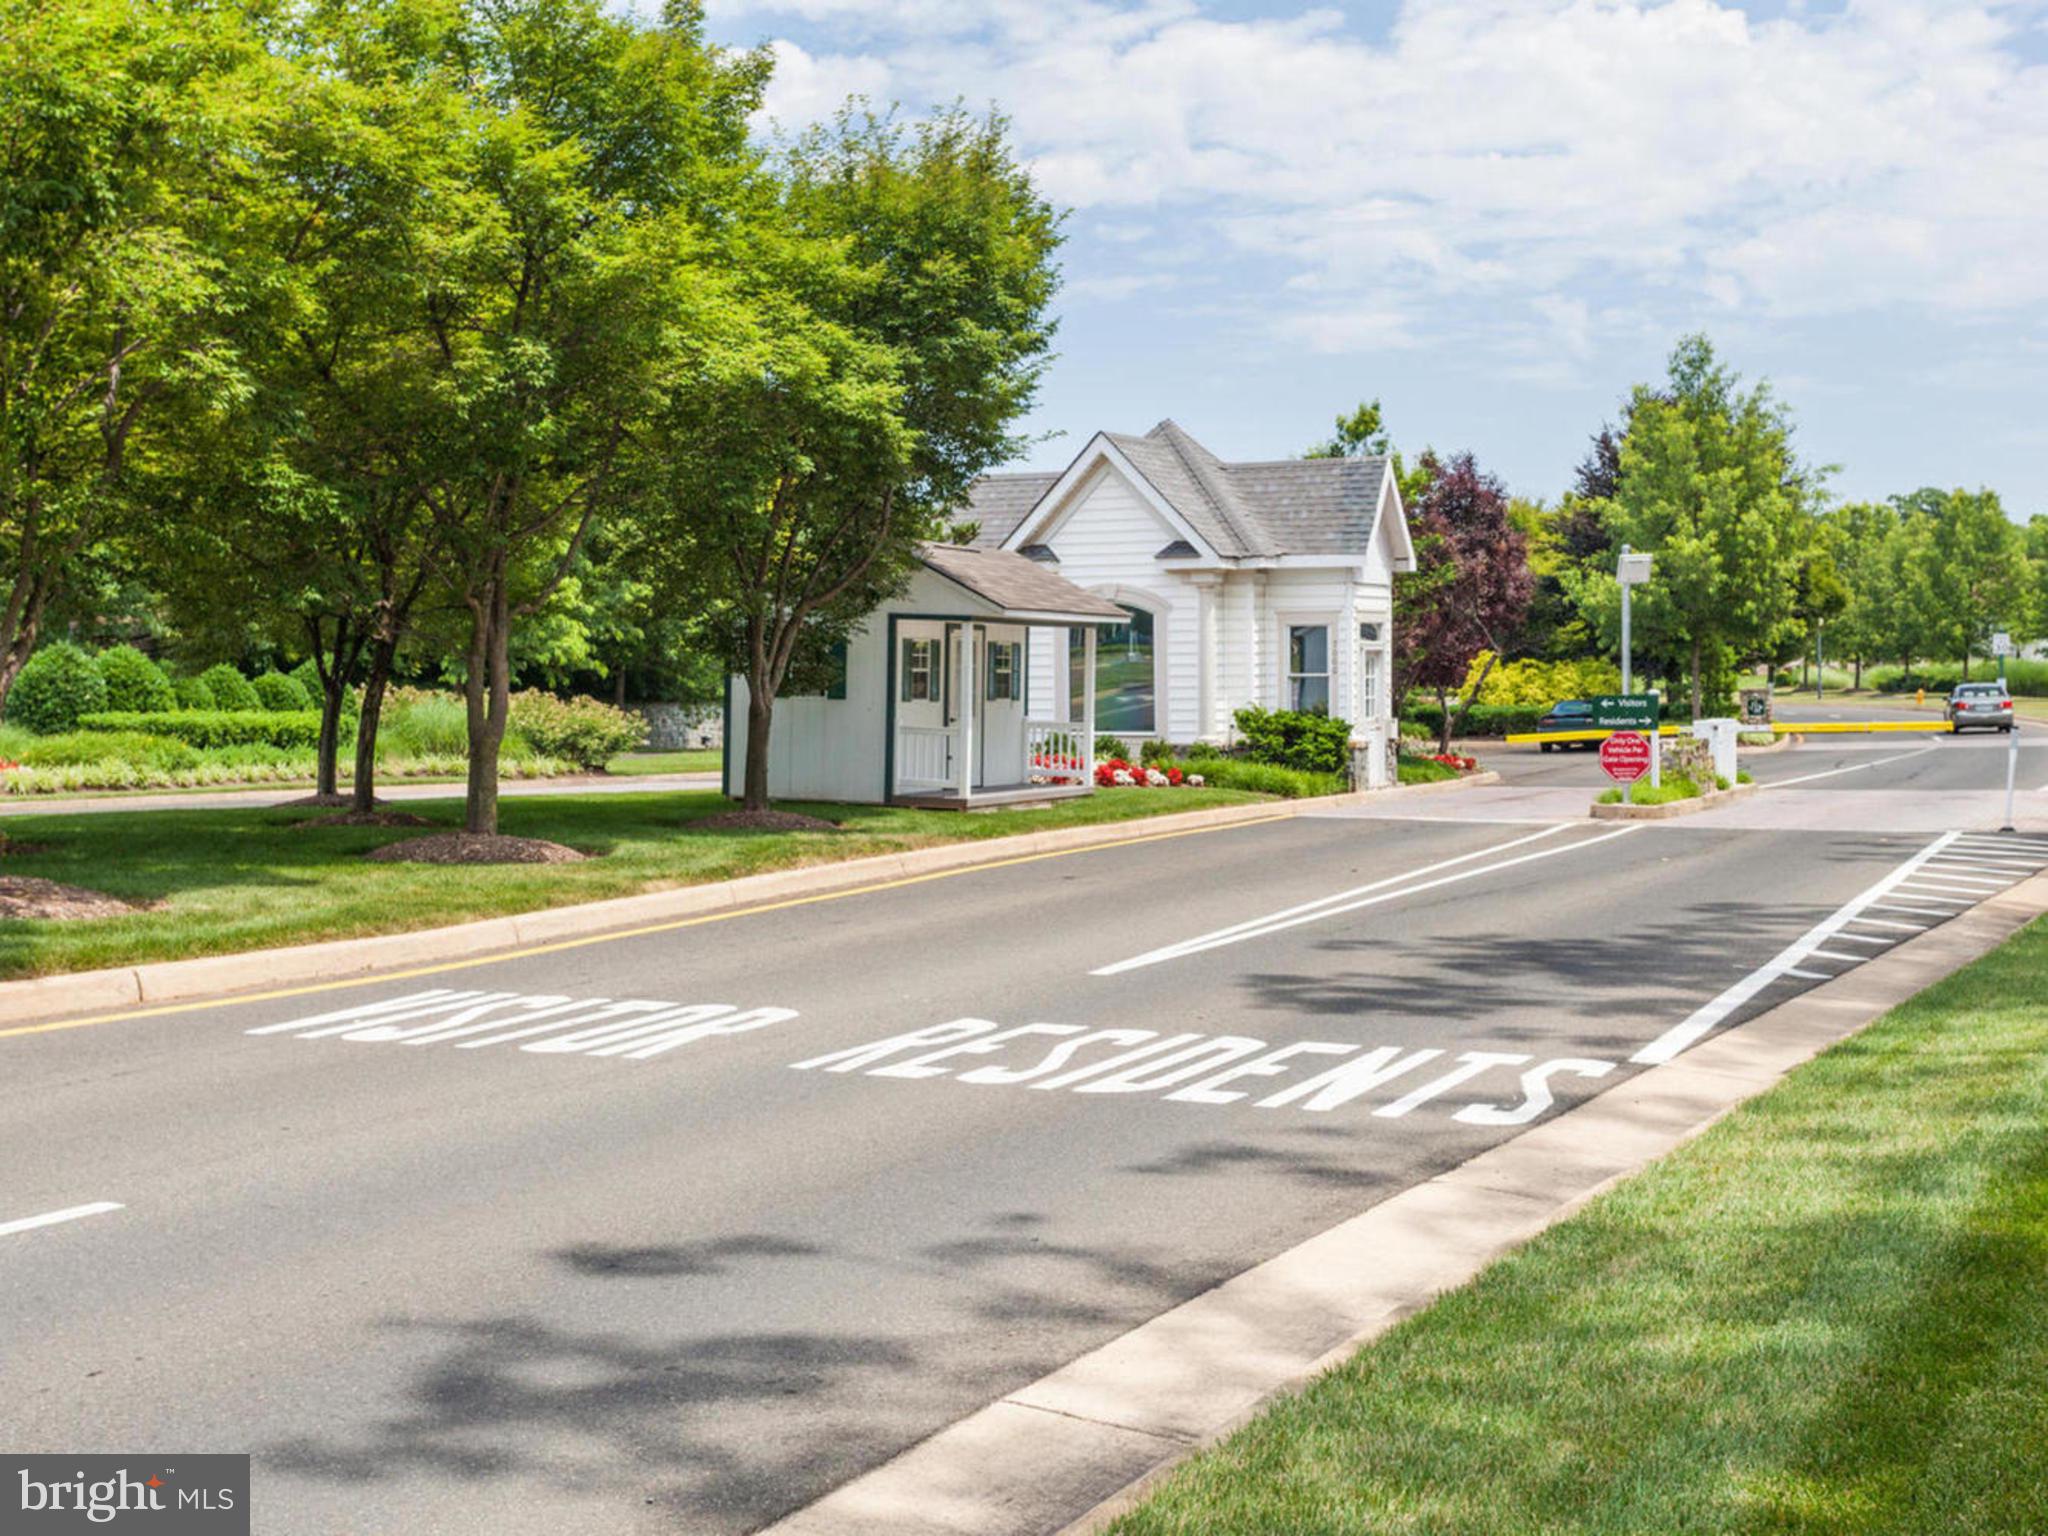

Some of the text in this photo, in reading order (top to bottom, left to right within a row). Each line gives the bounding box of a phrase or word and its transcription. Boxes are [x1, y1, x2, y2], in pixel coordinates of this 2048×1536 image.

[1599, 717, 1637, 726] Residents
[1617, 699, 1647, 707] Visitors
[244, 989, 800, 1060] VISITOR
[790, 1017, 1617, 1126] RESIDENTS
